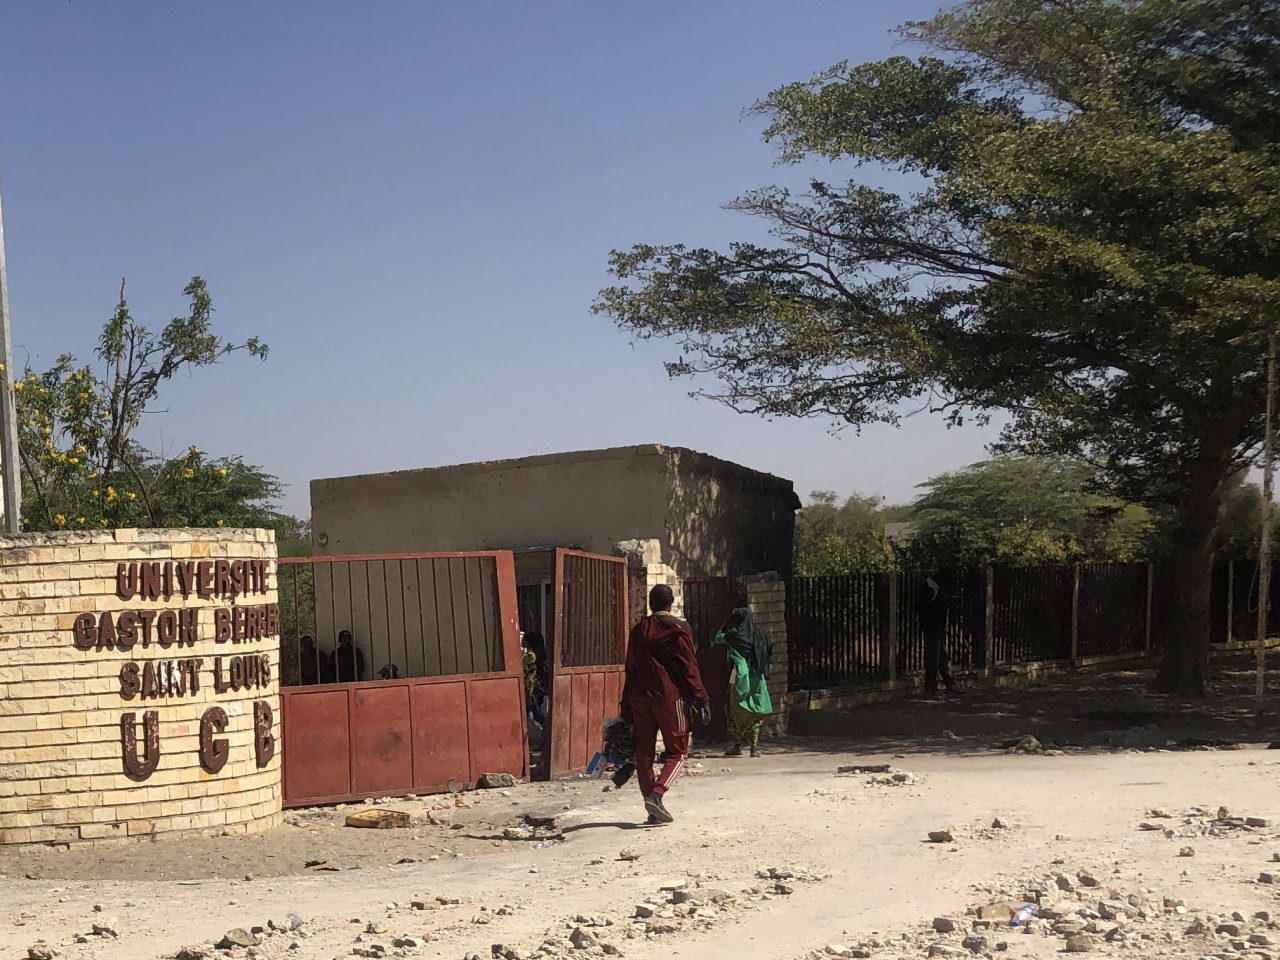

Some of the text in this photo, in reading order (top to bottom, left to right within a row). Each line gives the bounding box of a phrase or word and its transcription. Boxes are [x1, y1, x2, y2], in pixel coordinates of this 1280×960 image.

[117, 560, 270, 600] UNIVERSITE
[74, 608, 198, 651] GASTON
[120, 654, 271, 700] SAINT LOUIS
